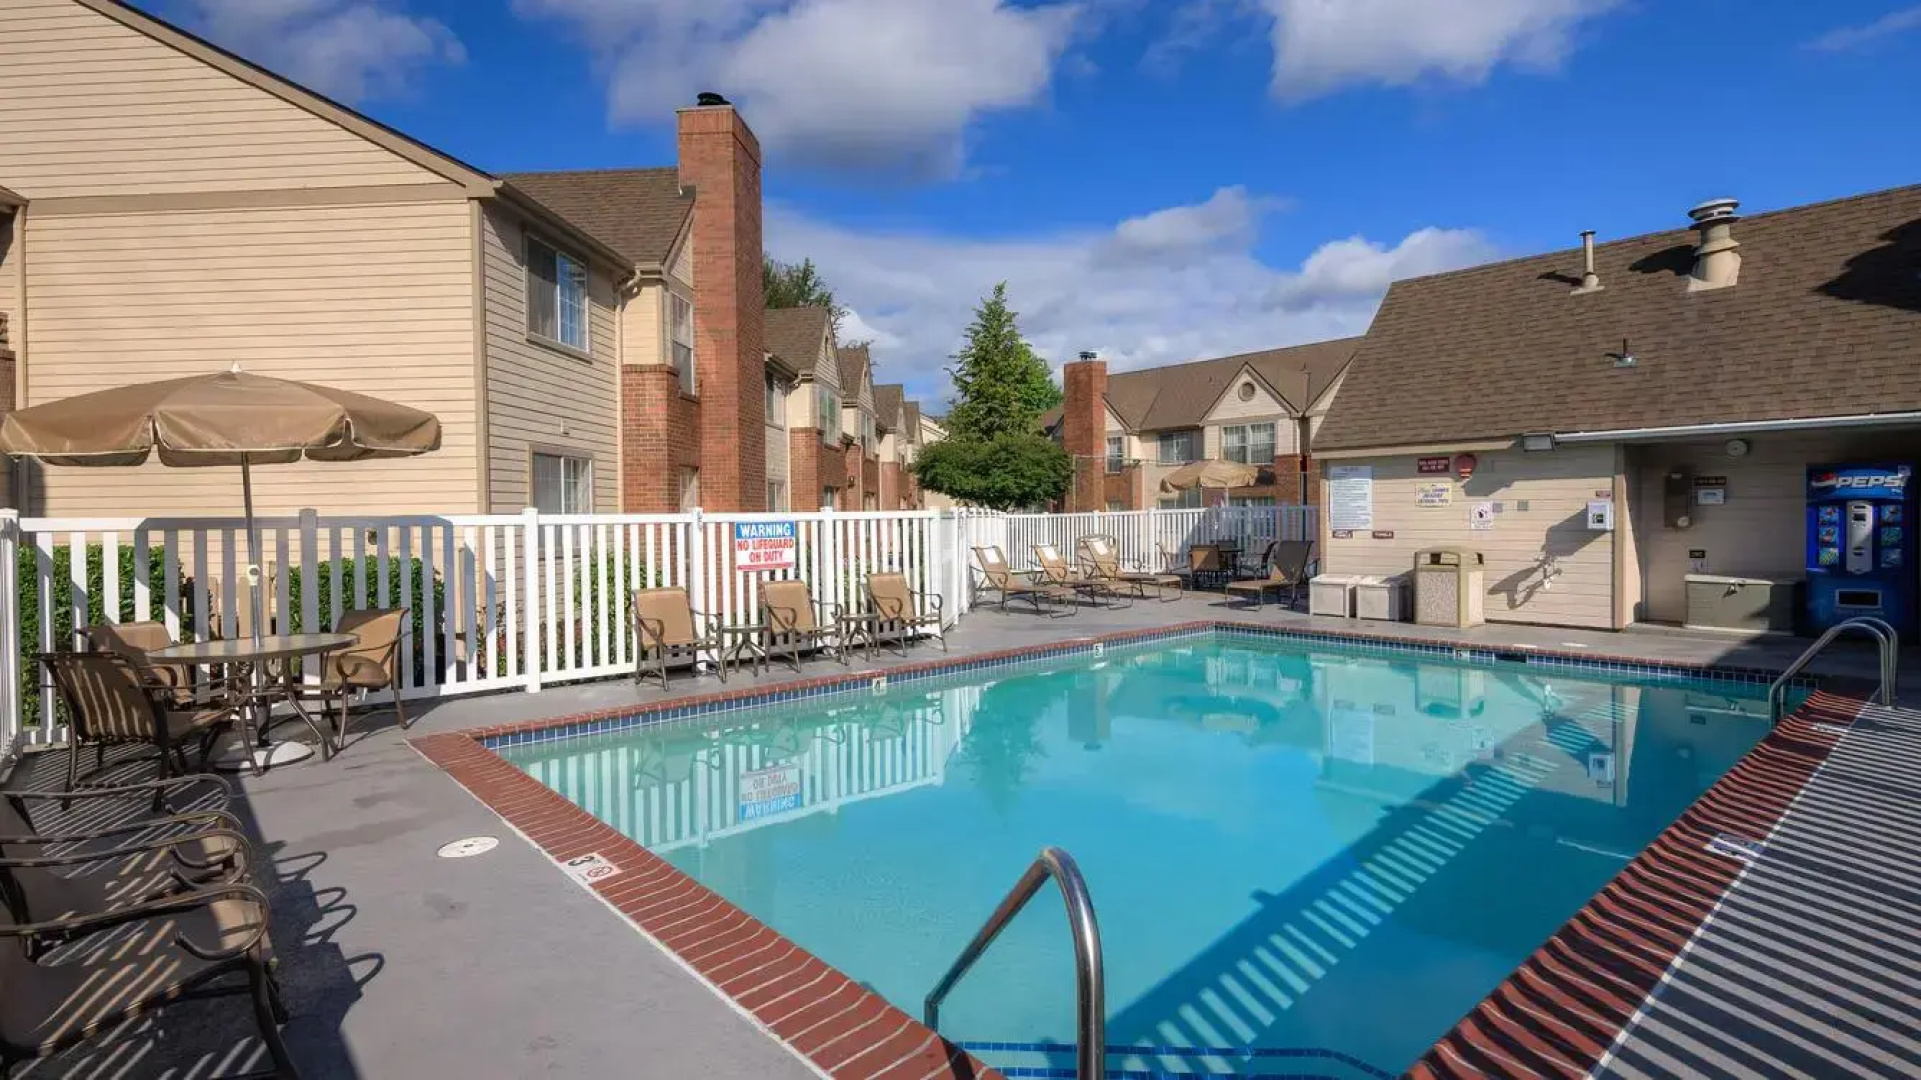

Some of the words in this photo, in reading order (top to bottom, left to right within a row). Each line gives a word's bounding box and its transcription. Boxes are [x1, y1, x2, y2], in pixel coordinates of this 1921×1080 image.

[741, 523, 791, 537] WARNING
[737, 540, 750, 551] NO
[751, 538, 795, 550] LIFEGUARD
[749, 551, 762, 562] ON
[764, 550, 784, 562] DUTY
[568, 856, 595, 866] 3
